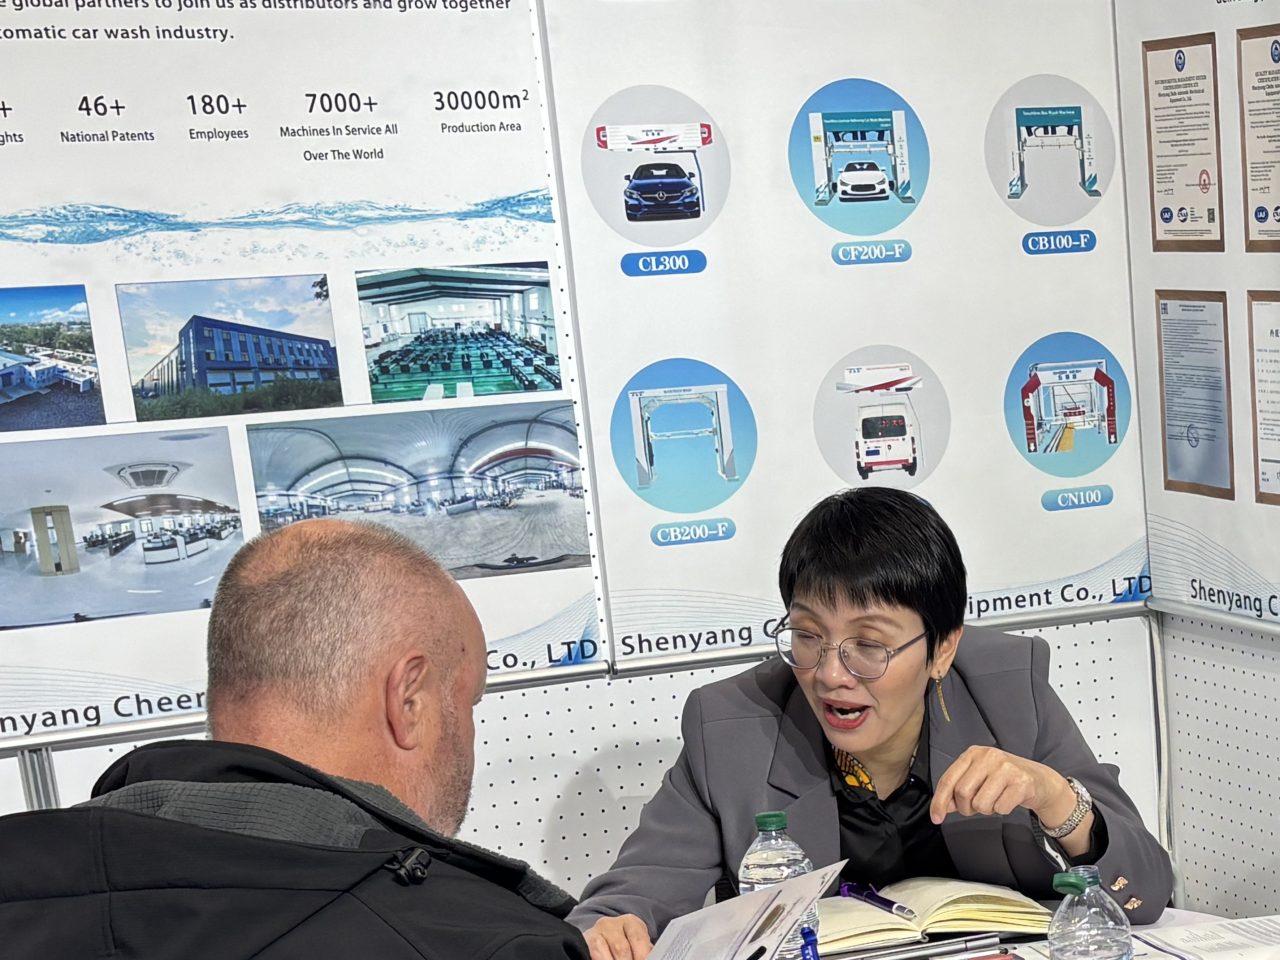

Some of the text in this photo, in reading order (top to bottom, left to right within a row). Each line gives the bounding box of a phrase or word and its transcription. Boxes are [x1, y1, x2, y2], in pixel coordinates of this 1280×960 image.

[12, 0, 69, 11] global
[74, 0, 150, 12] partners
[154, 0, 172, 8] to
[177, 0, 210, 12] join
[216, 0, 234, 8] us
[239, 0, 257, 8] as
[262, 0, 358, 9] distributors
[363, 0, 393, 9] and
[397, 0, 437, 13] grow
[442, 0, 511, 13] together
[72, 28, 99, 39] car
[104, 25, 150, 39] wash
[155, 25, 234, 42] industry.
[78, 95, 126, 116] 46+
[186, 94, 247, 115] 180+
[305, 92, 378, 113] 7000+
[60, 130, 155, 142] National Patents
[189, 128, 249, 142] Employees
[280, 123, 398, 137] Machines In Service All
[441, 121, 522, 133] Production Area
[303, 148, 384, 161] Over The World
[1028, 233, 1090, 251] CB100-F
[838, 243, 904, 260] CF200-F
[638, 255, 689, 272] CL300
[1057, 488, 1101, 507] CN100
[656, 522, 729, 542] CB200-F
[1060, 584, 1103, 602] Co.,
[1112, 575, 1151, 597] LTD
[1190, 578, 1263, 618] Shenyang
[621, 626, 752, 656] Shenyang
[486, 639, 598, 670] Co., LTD
[0, 691, 206, 736] nyang Cheer
